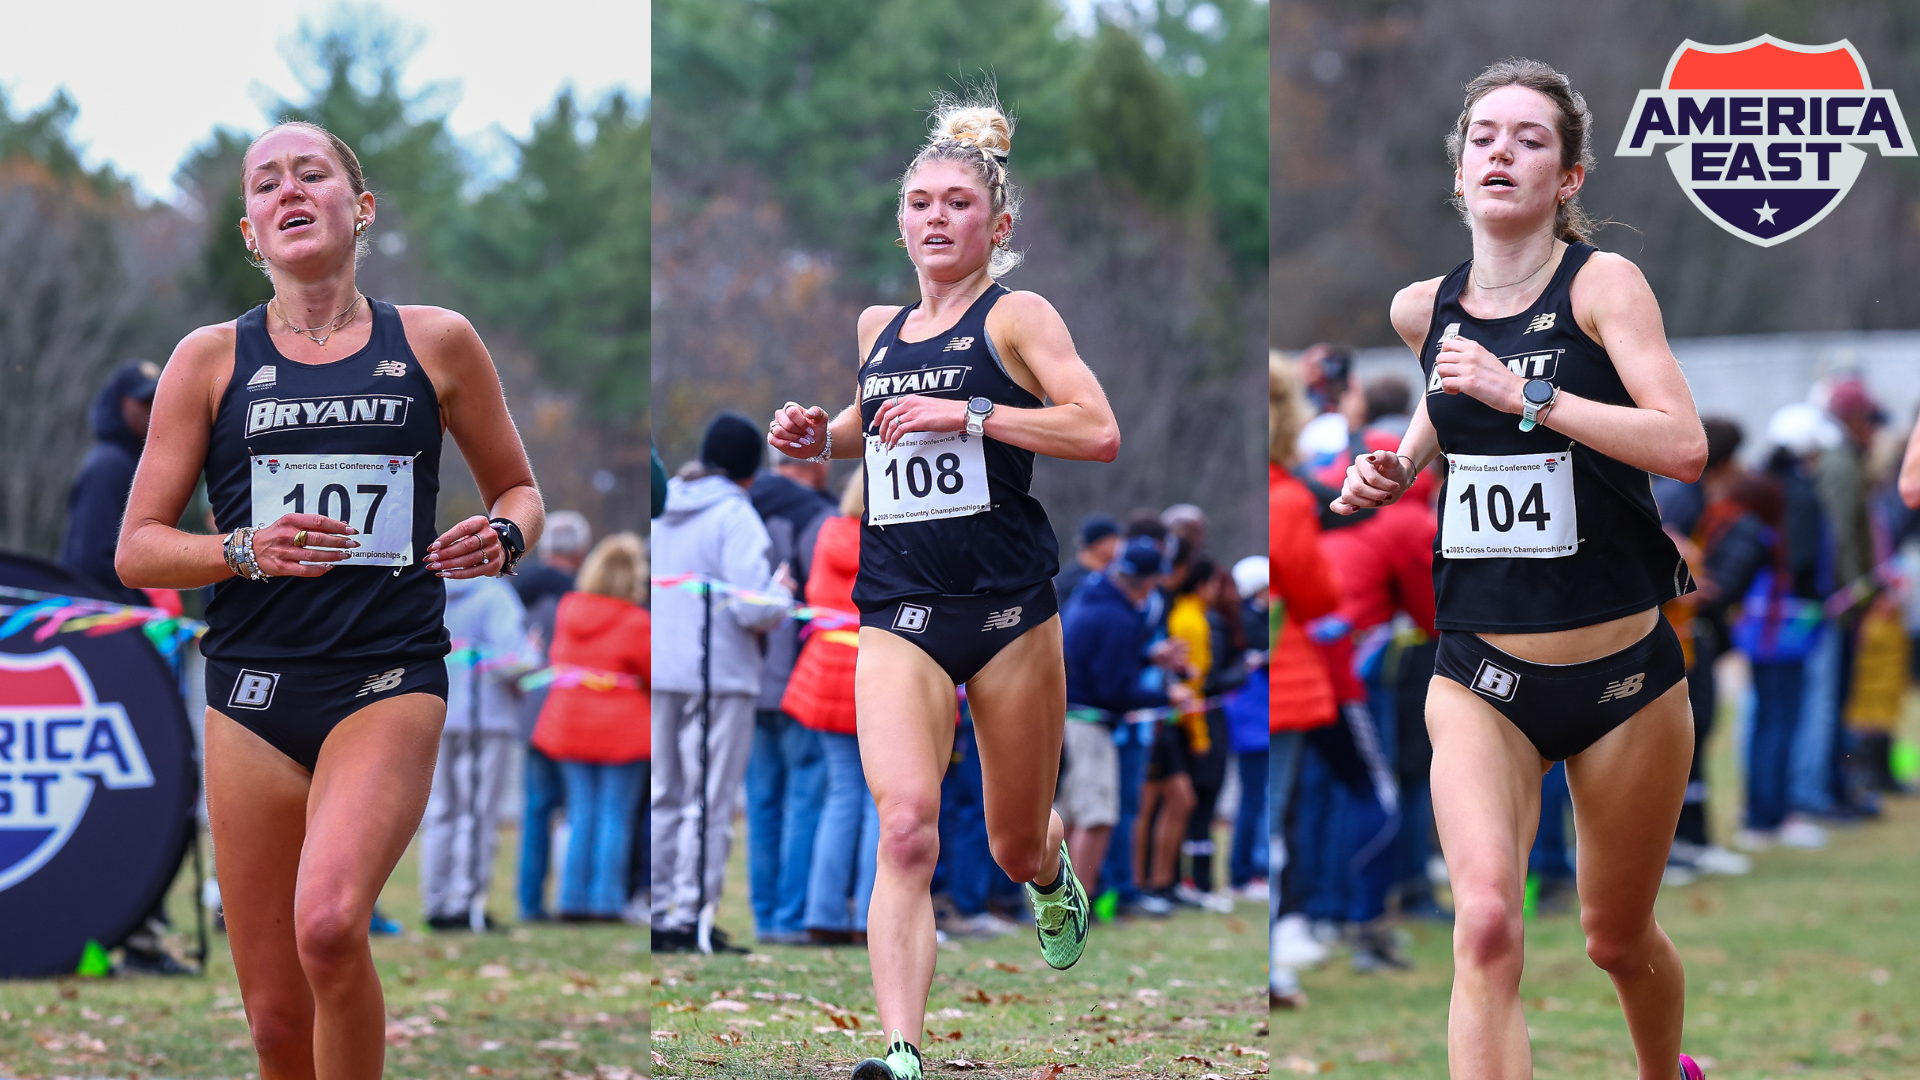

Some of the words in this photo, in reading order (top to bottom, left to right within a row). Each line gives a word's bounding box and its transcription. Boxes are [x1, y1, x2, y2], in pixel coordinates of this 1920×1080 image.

[862, 369, 960, 400] BRYANT
[248, 398, 403, 433] BRYANT
[919, 436, 955, 446] Conference
[885, 452, 964, 500] 108
[1484, 464, 1498, 472] East
[1499, 464, 1540, 472] Conference
[283, 483, 388, 535] 107
[889, 512, 905, 520] Cross
[905, 509, 929, 518] Country
[930, 503, 981, 515] Championships
[1459, 482, 1551, 532] 104
[1486, 546, 1512, 554] Country
[1513, 545, 1567, 553] Championships
